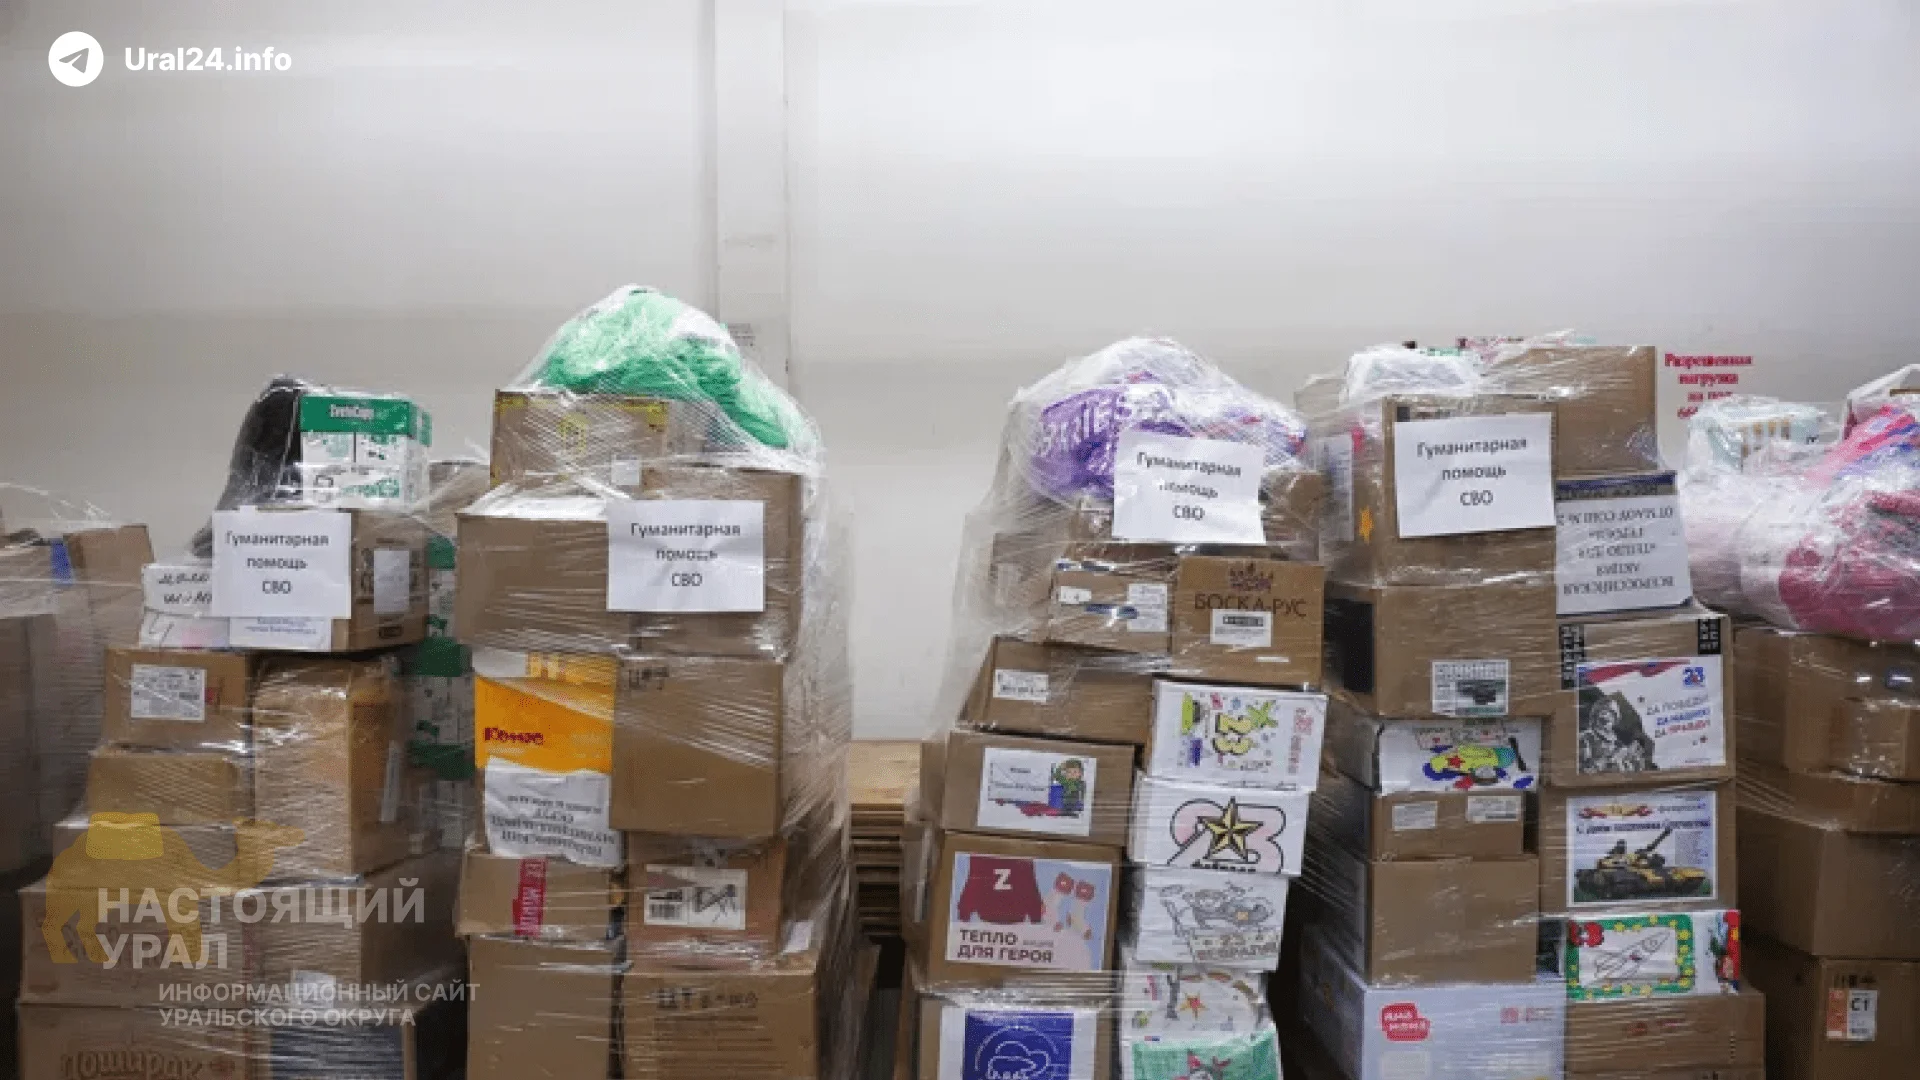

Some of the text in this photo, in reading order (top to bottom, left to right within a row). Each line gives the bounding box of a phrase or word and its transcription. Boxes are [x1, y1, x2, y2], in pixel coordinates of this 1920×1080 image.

[1416, 438, 1527, 461] Гуманитарная
[1136, 450, 1242, 478] Гуманитарная
[1441, 466, 1508, 482] помощь
[1159, 481, 1219, 500] помощь
[1459, 489, 1494, 507] СВО
[1172, 504, 1206, 522] СВО
[225, 530, 329, 549] Гуманитарная
[630, 522, 741, 541] Гуманитарная
[246, 557, 308, 572] помощь
[656, 547, 719, 564] помощь
[261, 580, 292, 595] СВО
[670, 572, 703, 587] СВО
[1563, 576, 1674, 594] ВСЕРОССИЙСКАЯ
[993, 868, 1013, 891] Z
[959, 929, 1018, 946] ТЕПЛО
[957, 944, 1052, 963] ДЛЯ ГЕРОЯ
